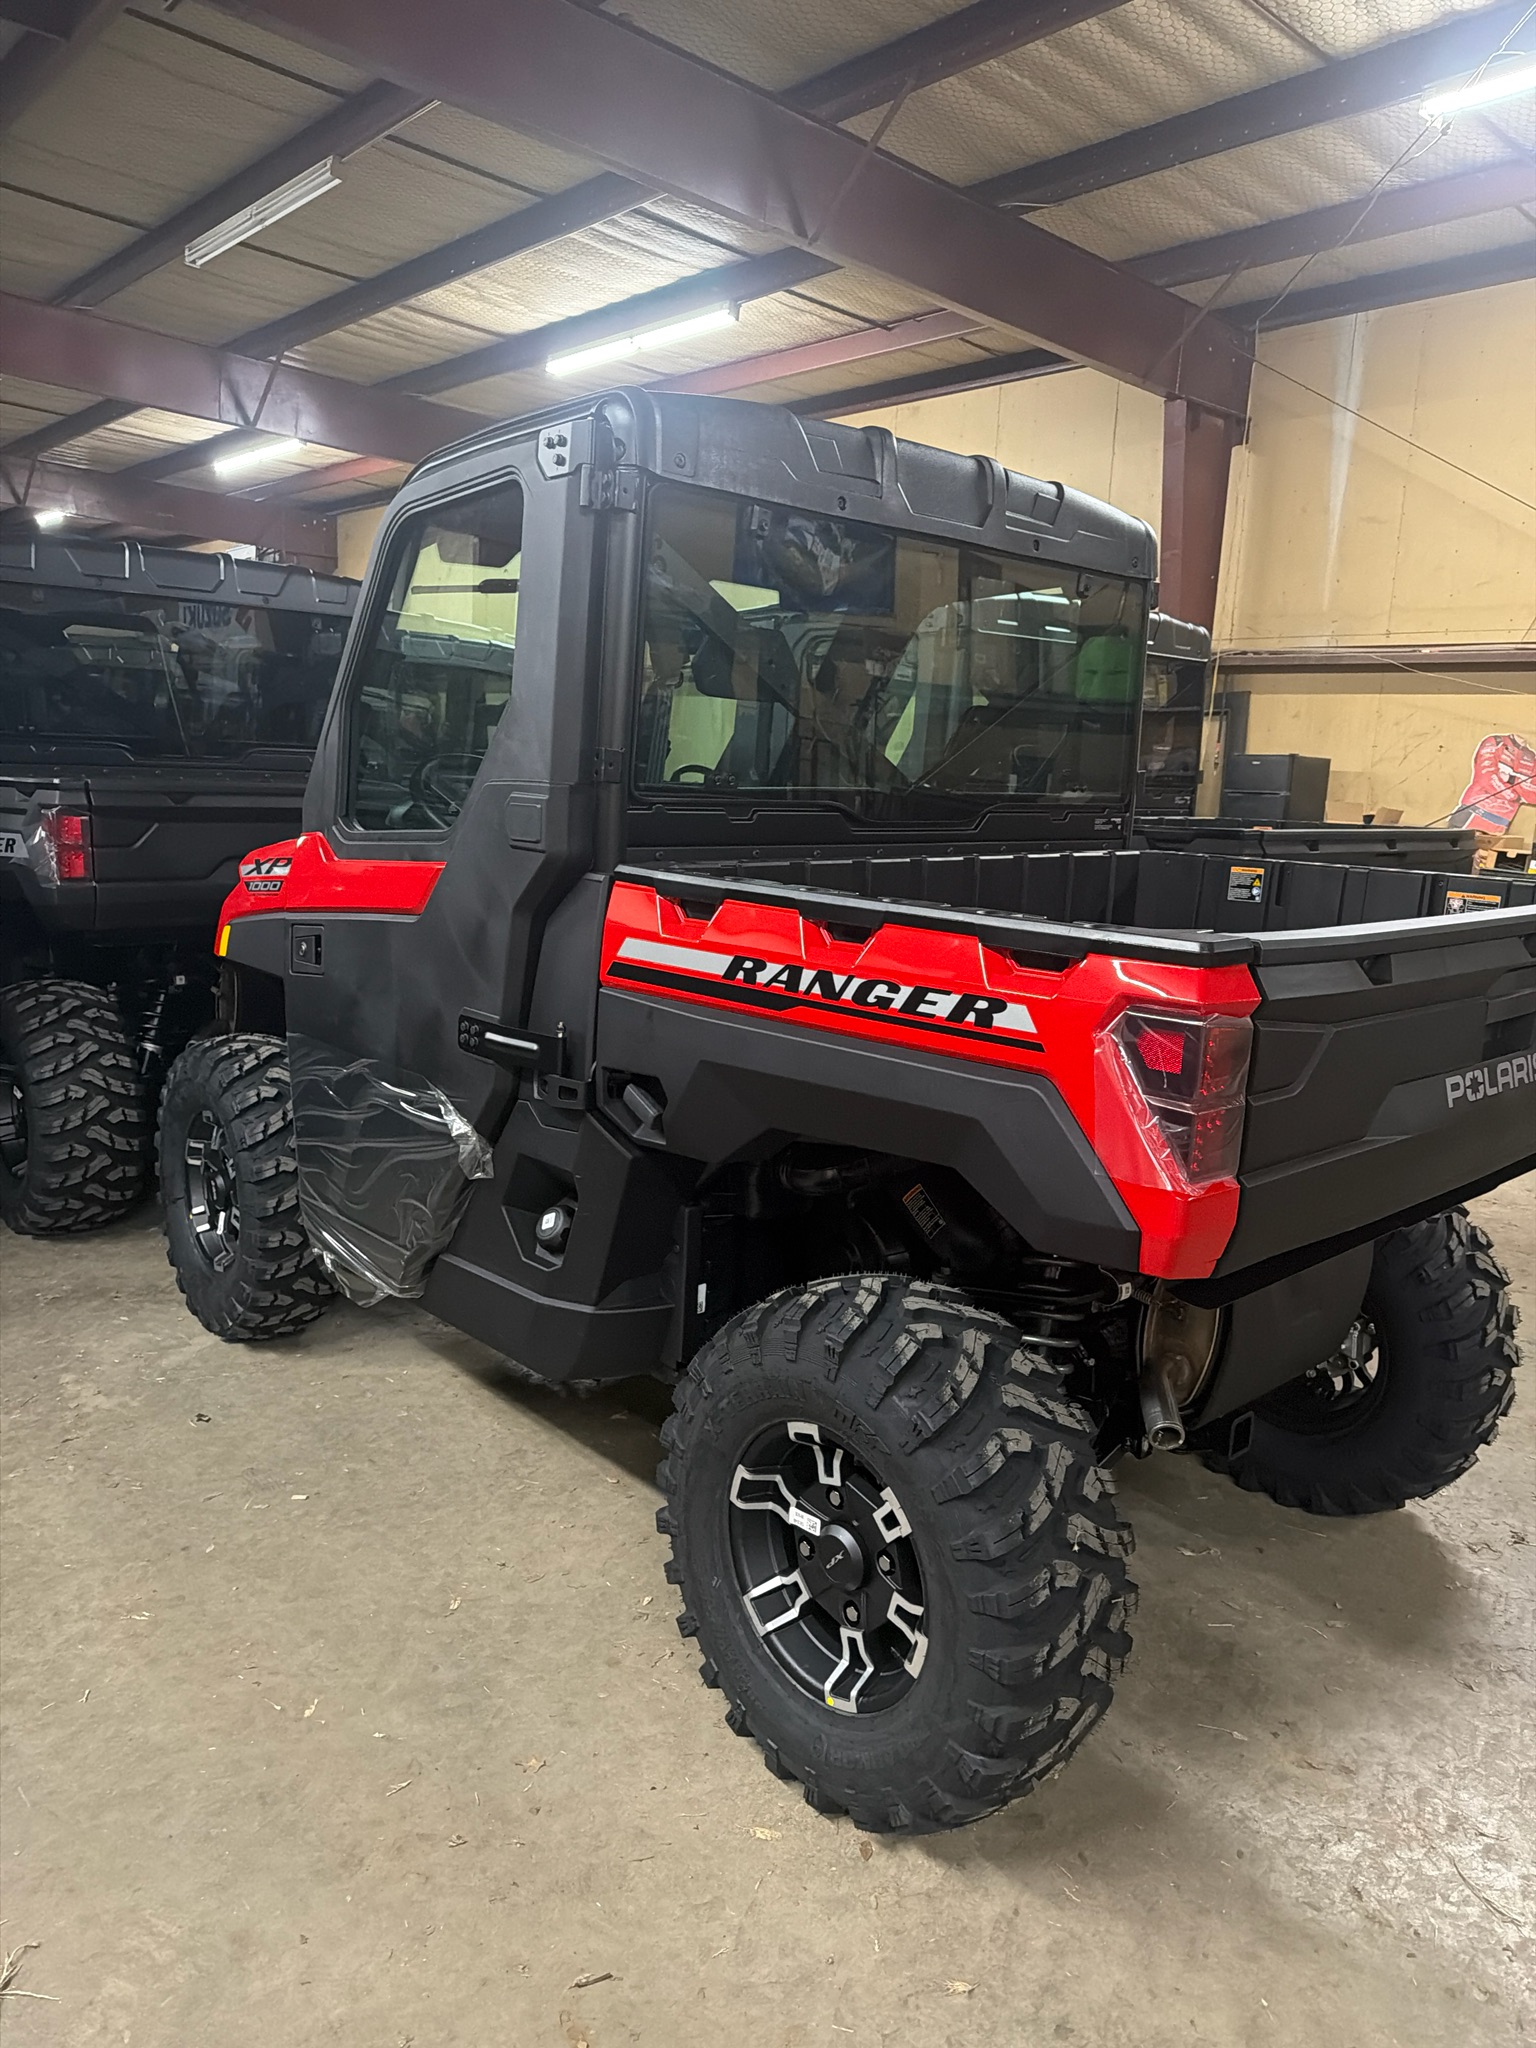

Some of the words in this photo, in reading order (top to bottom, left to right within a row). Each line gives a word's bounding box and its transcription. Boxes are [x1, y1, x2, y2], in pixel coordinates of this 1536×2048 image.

[244, 857, 293, 876] XP
[248, 881, 281, 891] 1000
[721, 955, 1008, 1029] RANGER
[1445, 1053, 1536, 1109] POLARI
